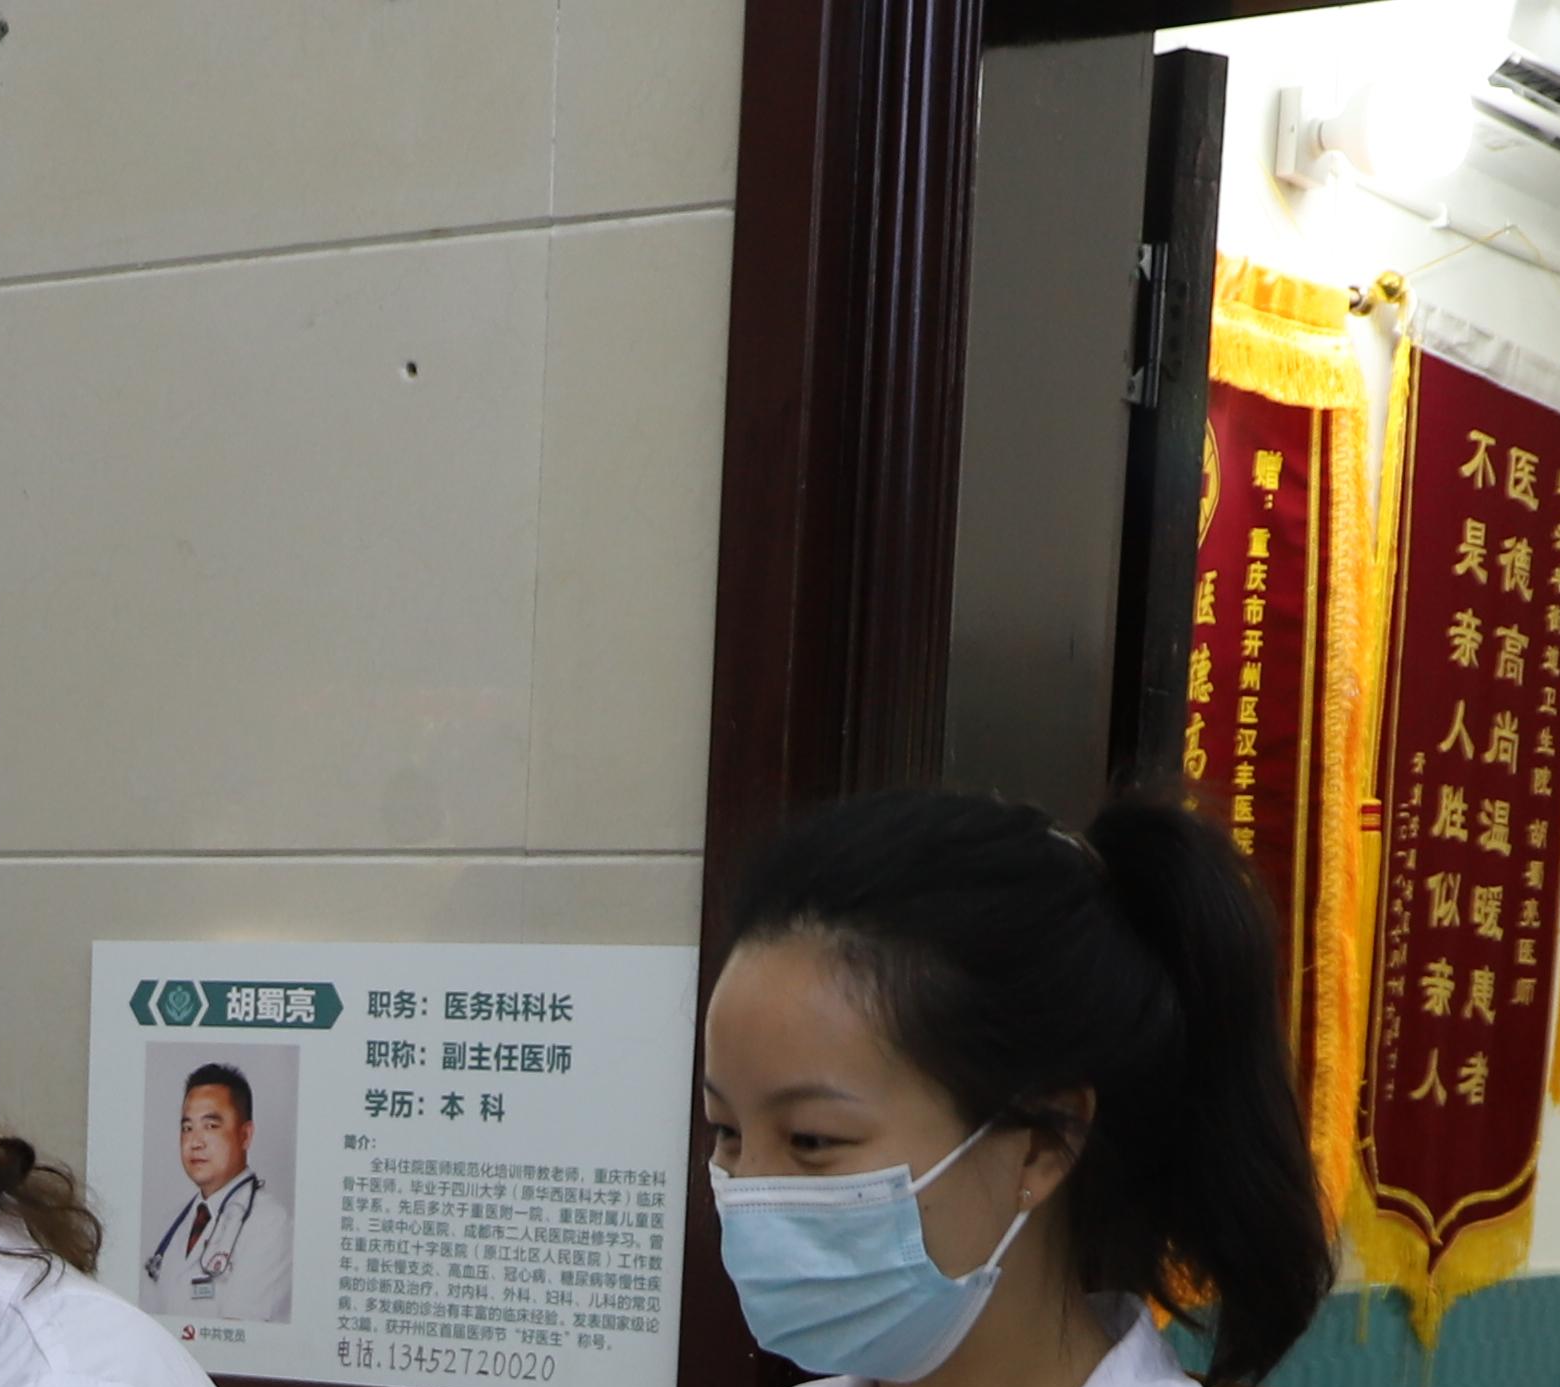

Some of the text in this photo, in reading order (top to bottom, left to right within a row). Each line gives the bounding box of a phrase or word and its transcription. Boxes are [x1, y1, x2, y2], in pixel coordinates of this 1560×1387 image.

[1181, 569, 1219, 812] 医德高
[1410, 427, 1498, 1108] 不是亲人胜似亲人
[1455, 446, 1543, 1108] 医德高尚温暖患者
[225, 986, 317, 1024] 胡蜀亮
[367, 989, 574, 1023] 职务：医务科科长
[365, 1039, 574, 1075] 职称：副主任医师
[343, 1134, 378, 1151] 简介：
[198, 1324, 247, 1345] 中共党员
